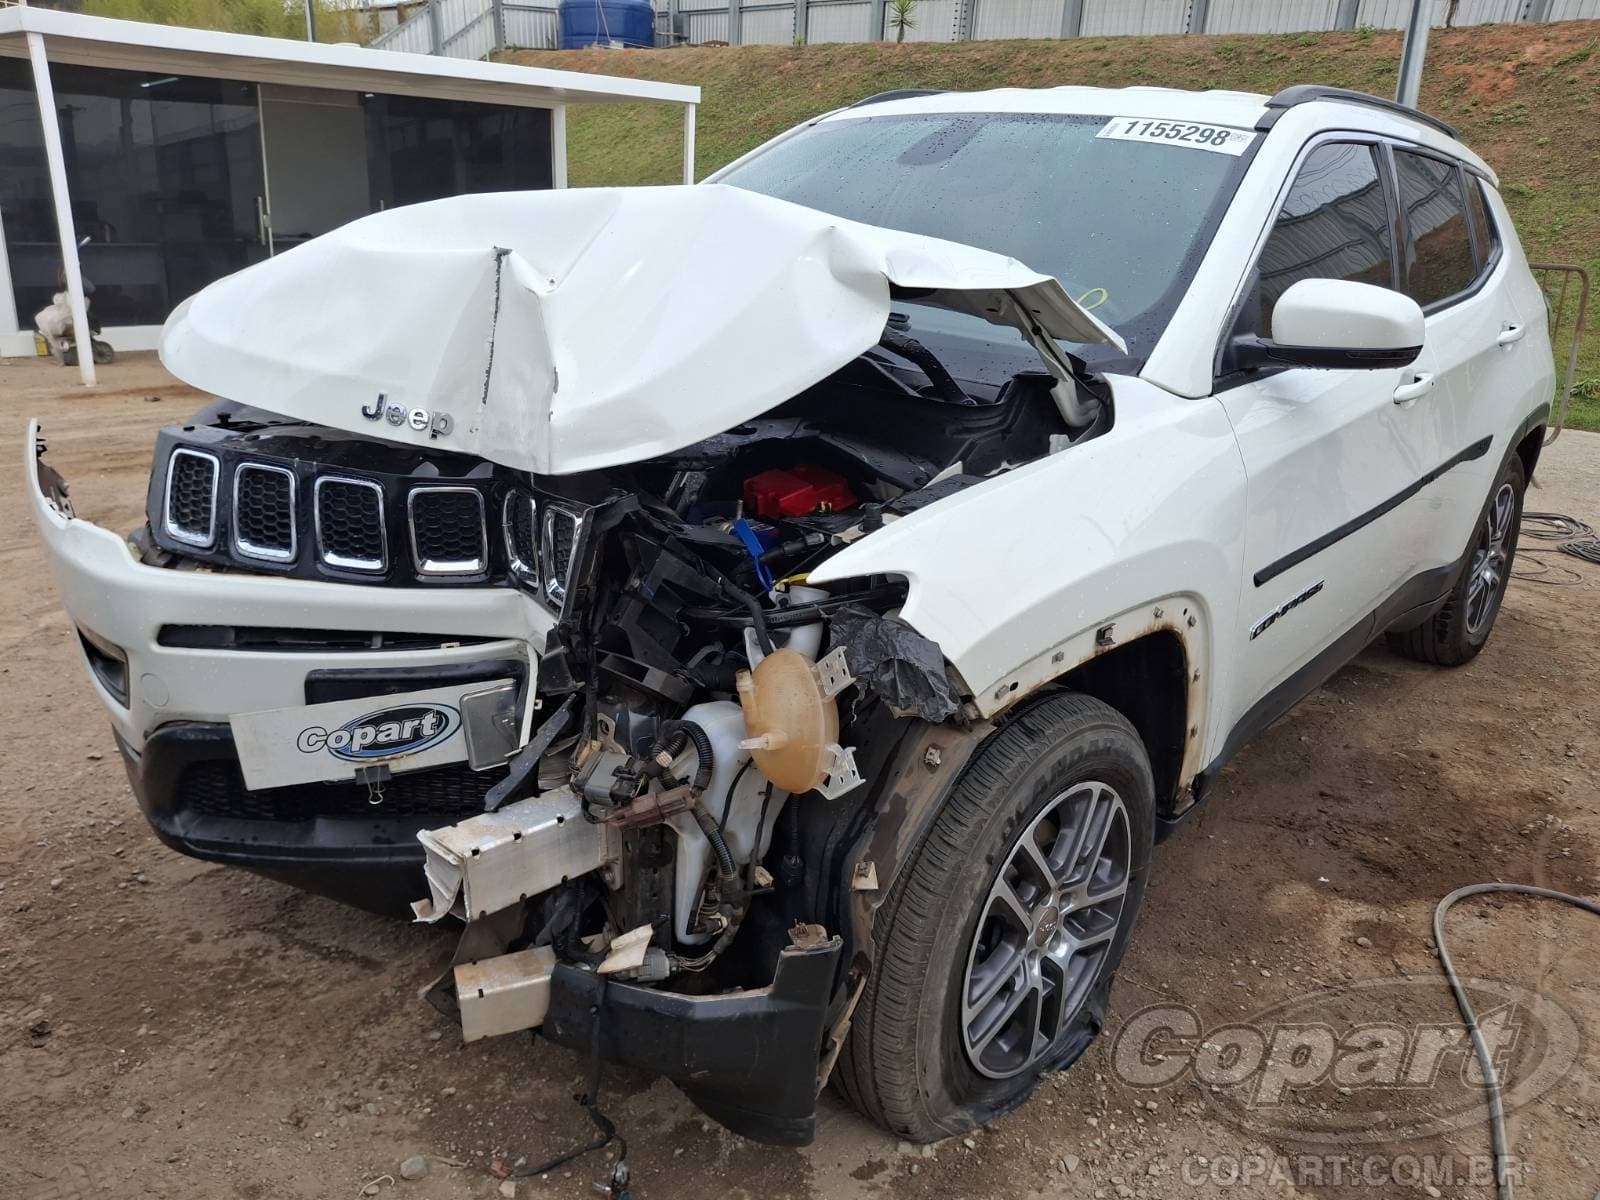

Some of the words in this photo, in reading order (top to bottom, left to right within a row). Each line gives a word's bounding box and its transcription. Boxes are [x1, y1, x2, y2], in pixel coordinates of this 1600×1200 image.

[1124, 120, 1231, 146] 1155298
[361, 393, 455, 440] Jeep
[297, 711, 439, 753] Copart
